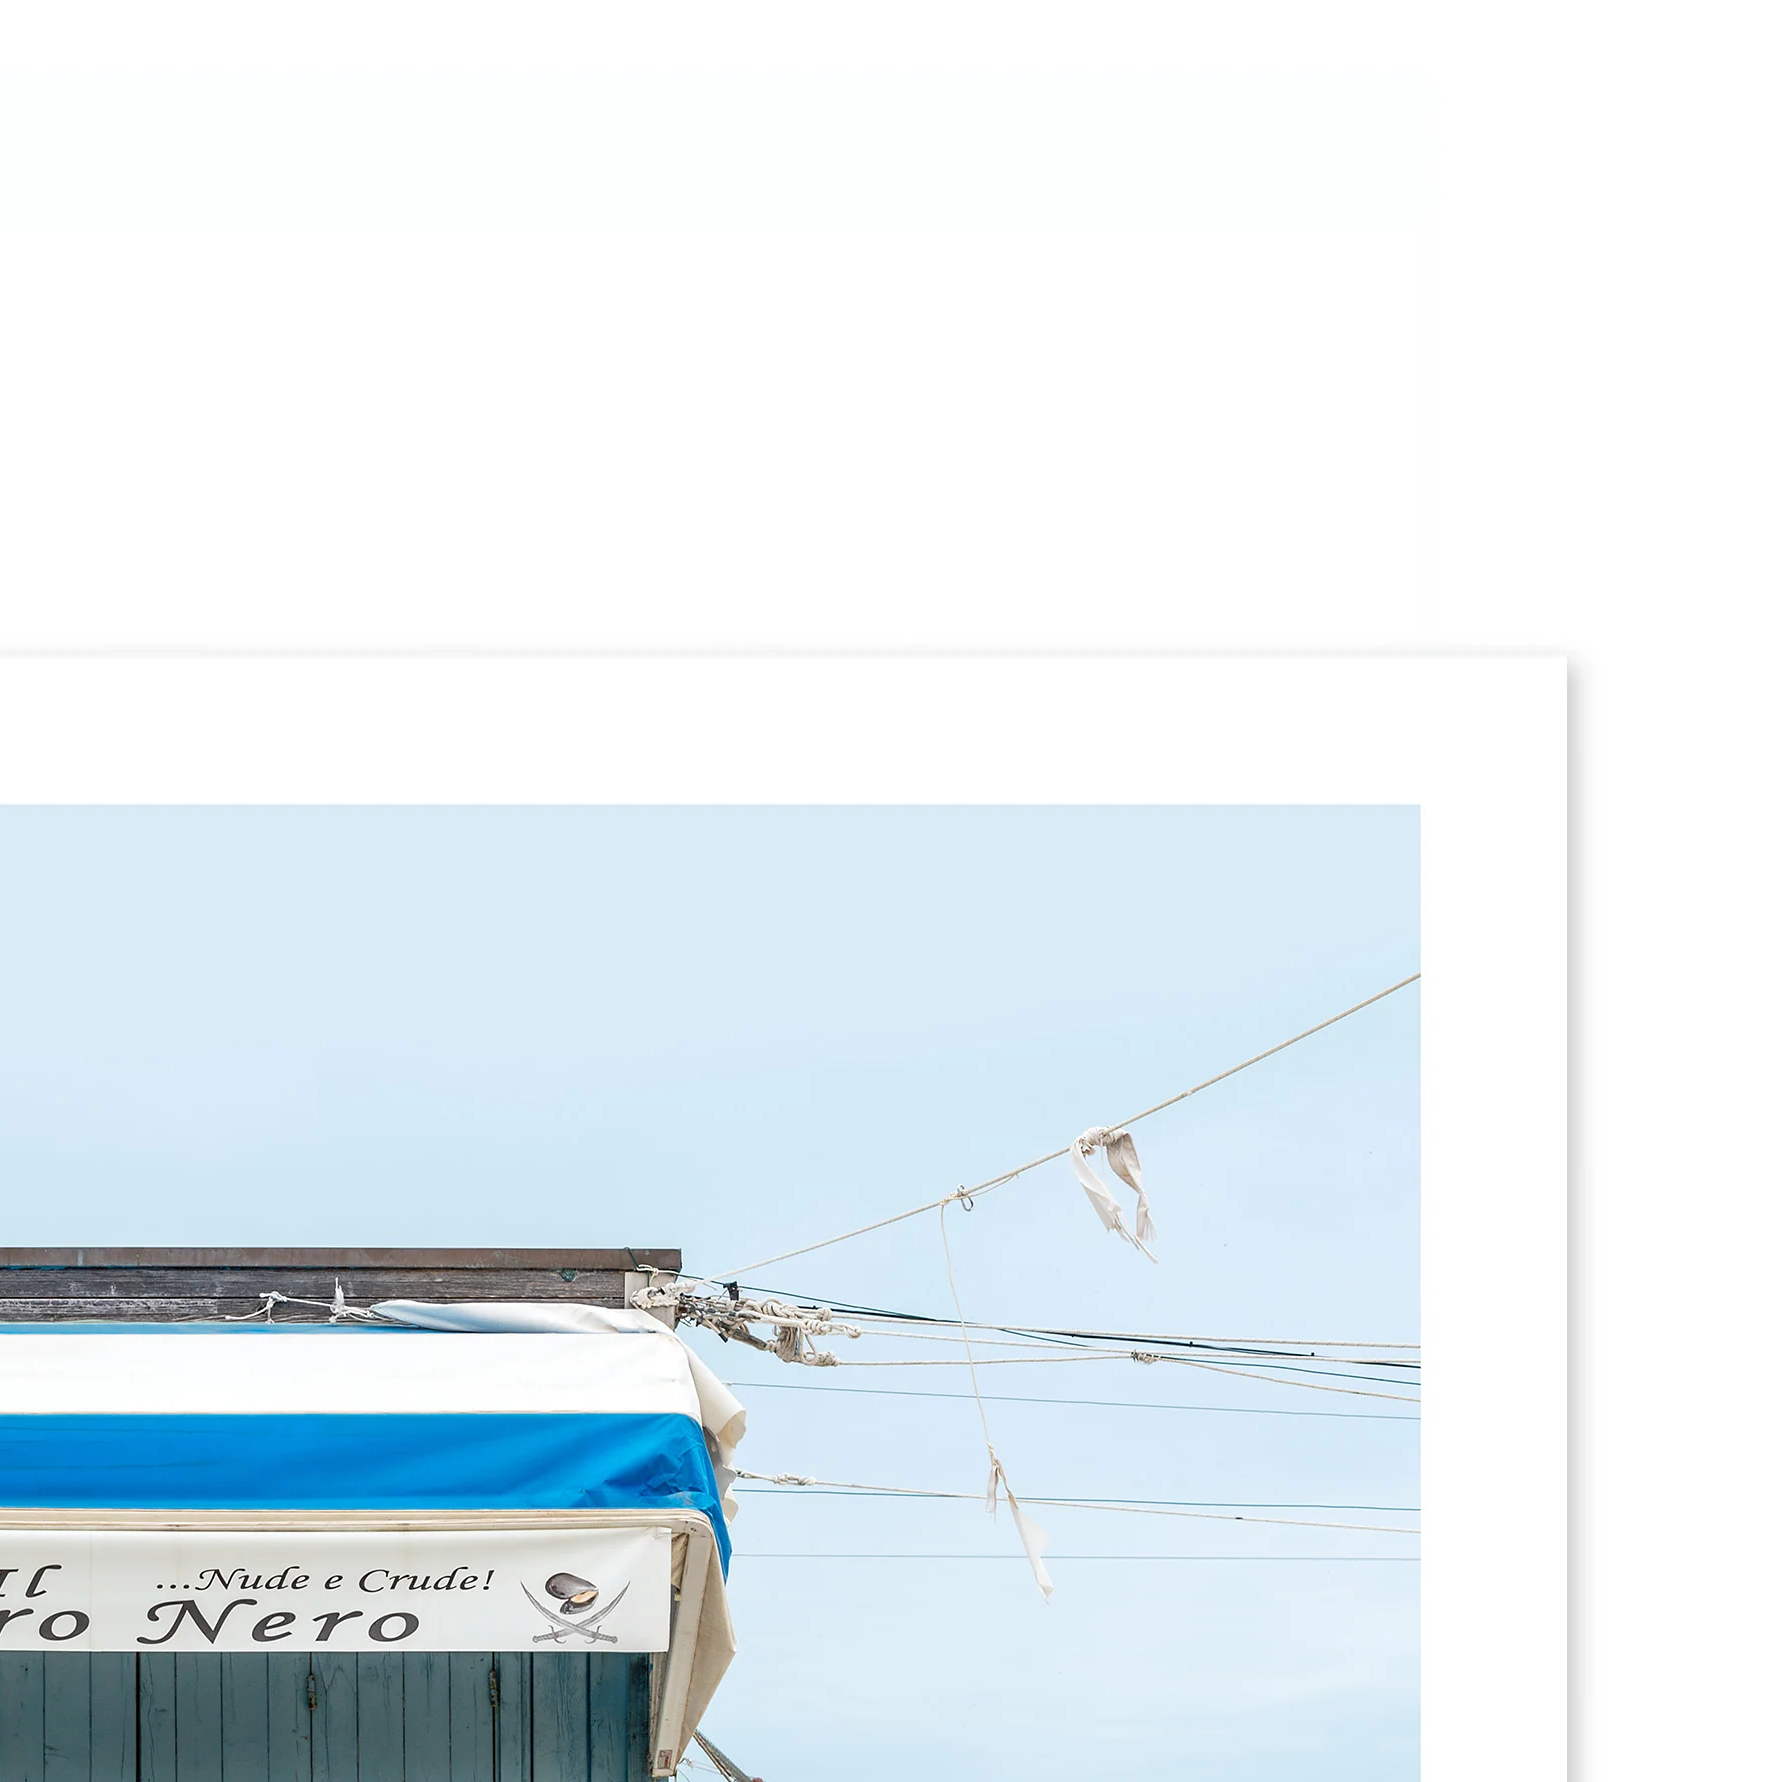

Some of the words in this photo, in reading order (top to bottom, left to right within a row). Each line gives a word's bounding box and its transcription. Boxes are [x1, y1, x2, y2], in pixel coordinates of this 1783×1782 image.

[156, 1565, 310, 1592] ...Nude
[324, 1574, 344, 1591] e
[358, 1566, 495, 1593] Crude!
[136, 1598, 420, 1645] Nero
